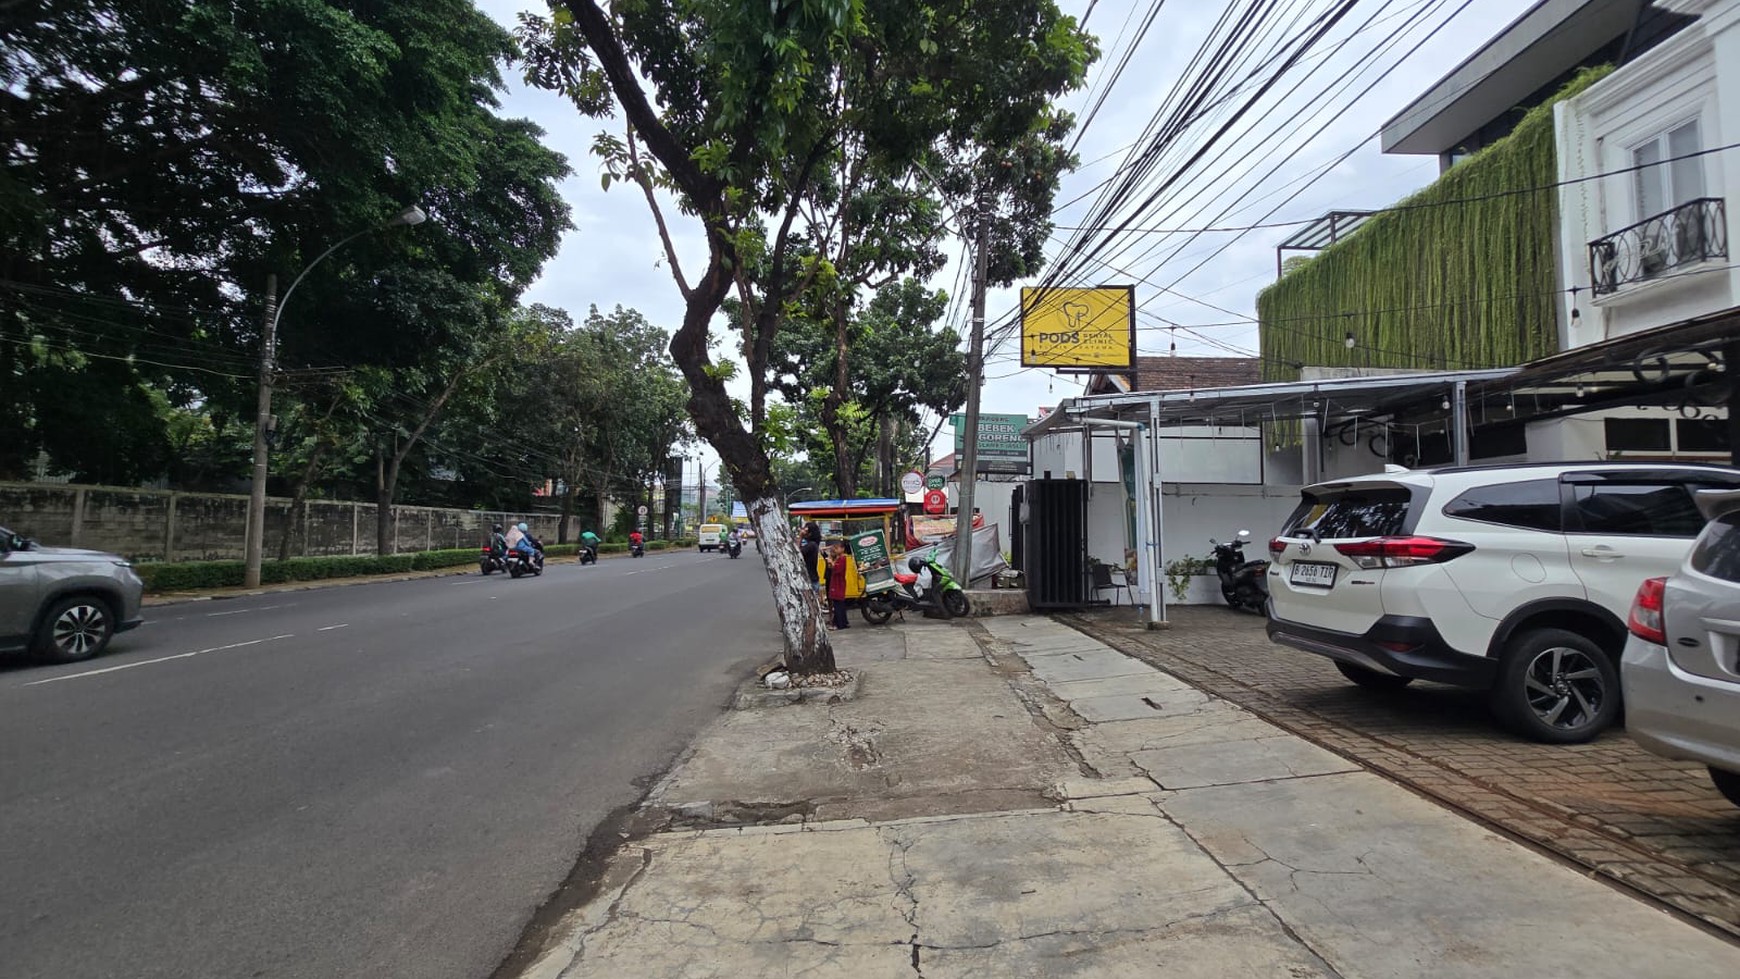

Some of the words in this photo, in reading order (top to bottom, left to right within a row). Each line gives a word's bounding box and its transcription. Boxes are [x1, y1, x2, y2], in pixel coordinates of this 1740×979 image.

[1040, 333, 1080, 344] PODS
[978, 423, 1015, 433] BEBEK
[1295, 564, 1300, 575] B
